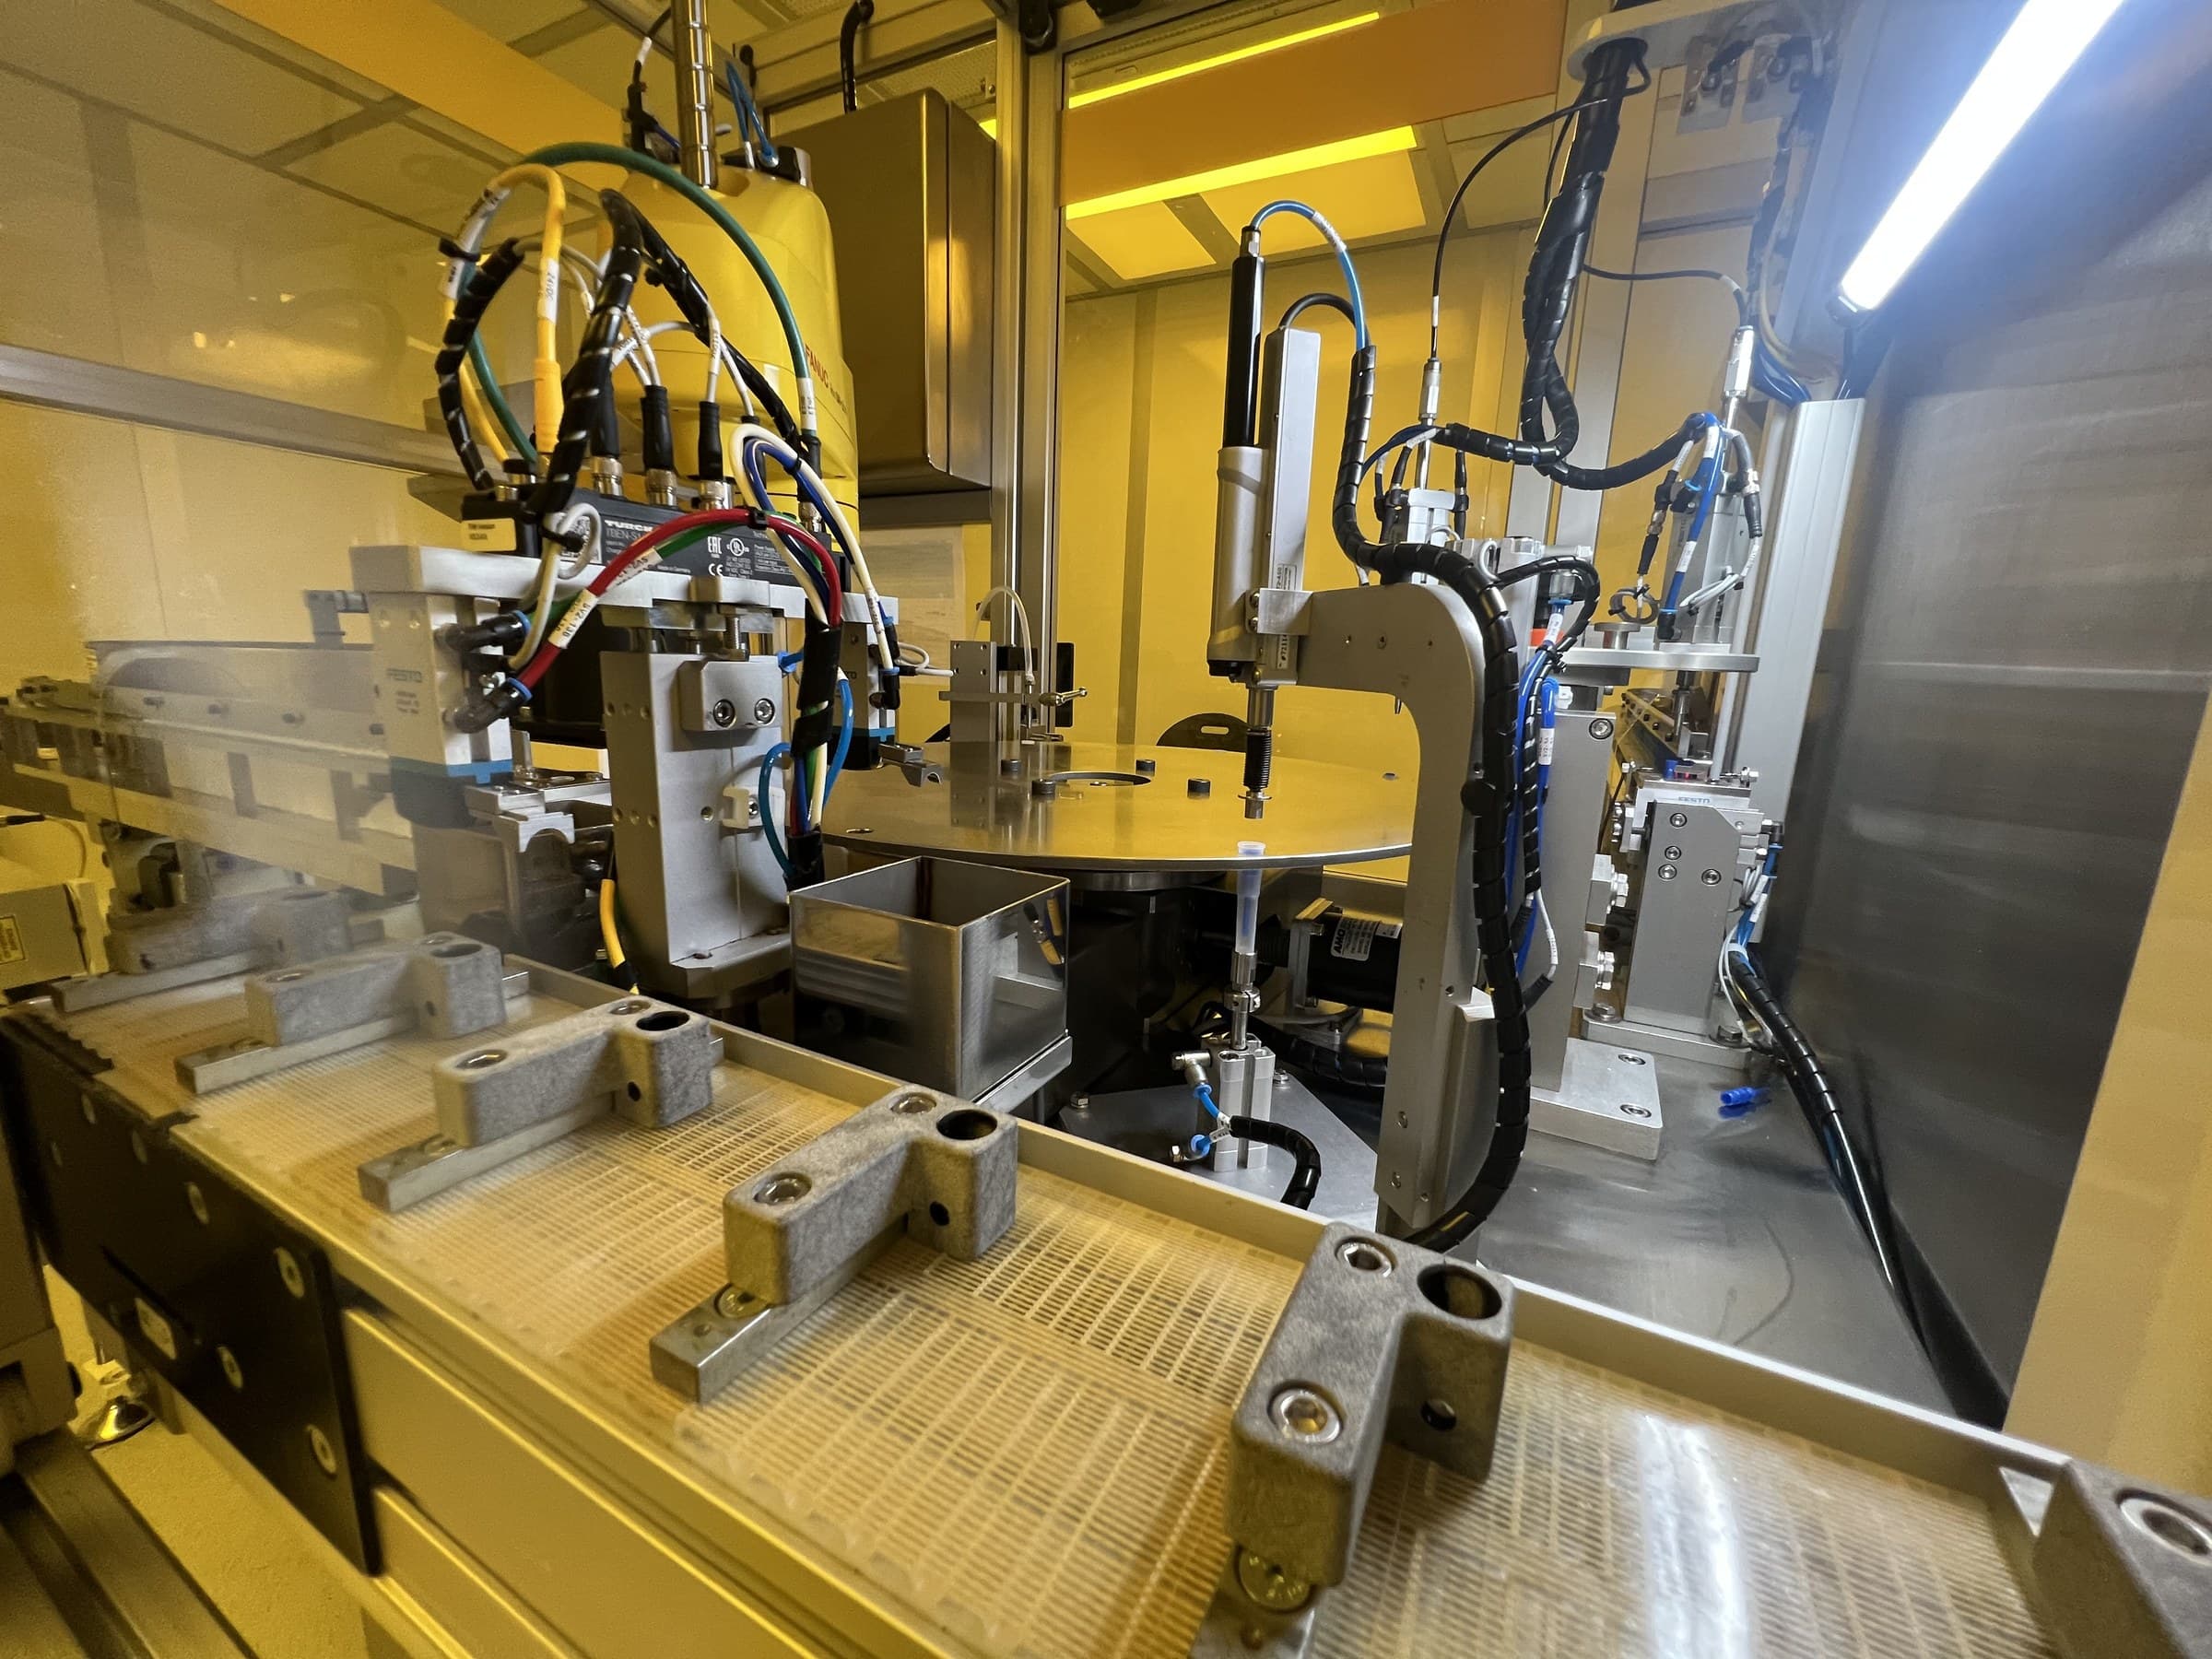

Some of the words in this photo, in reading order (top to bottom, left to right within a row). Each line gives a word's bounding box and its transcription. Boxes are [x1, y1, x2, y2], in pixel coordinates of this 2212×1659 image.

[805, 344, 829, 389] FANUC
[605, 520, 653, 532] TURCK
[1678, 796, 1711, 805] FESTO
